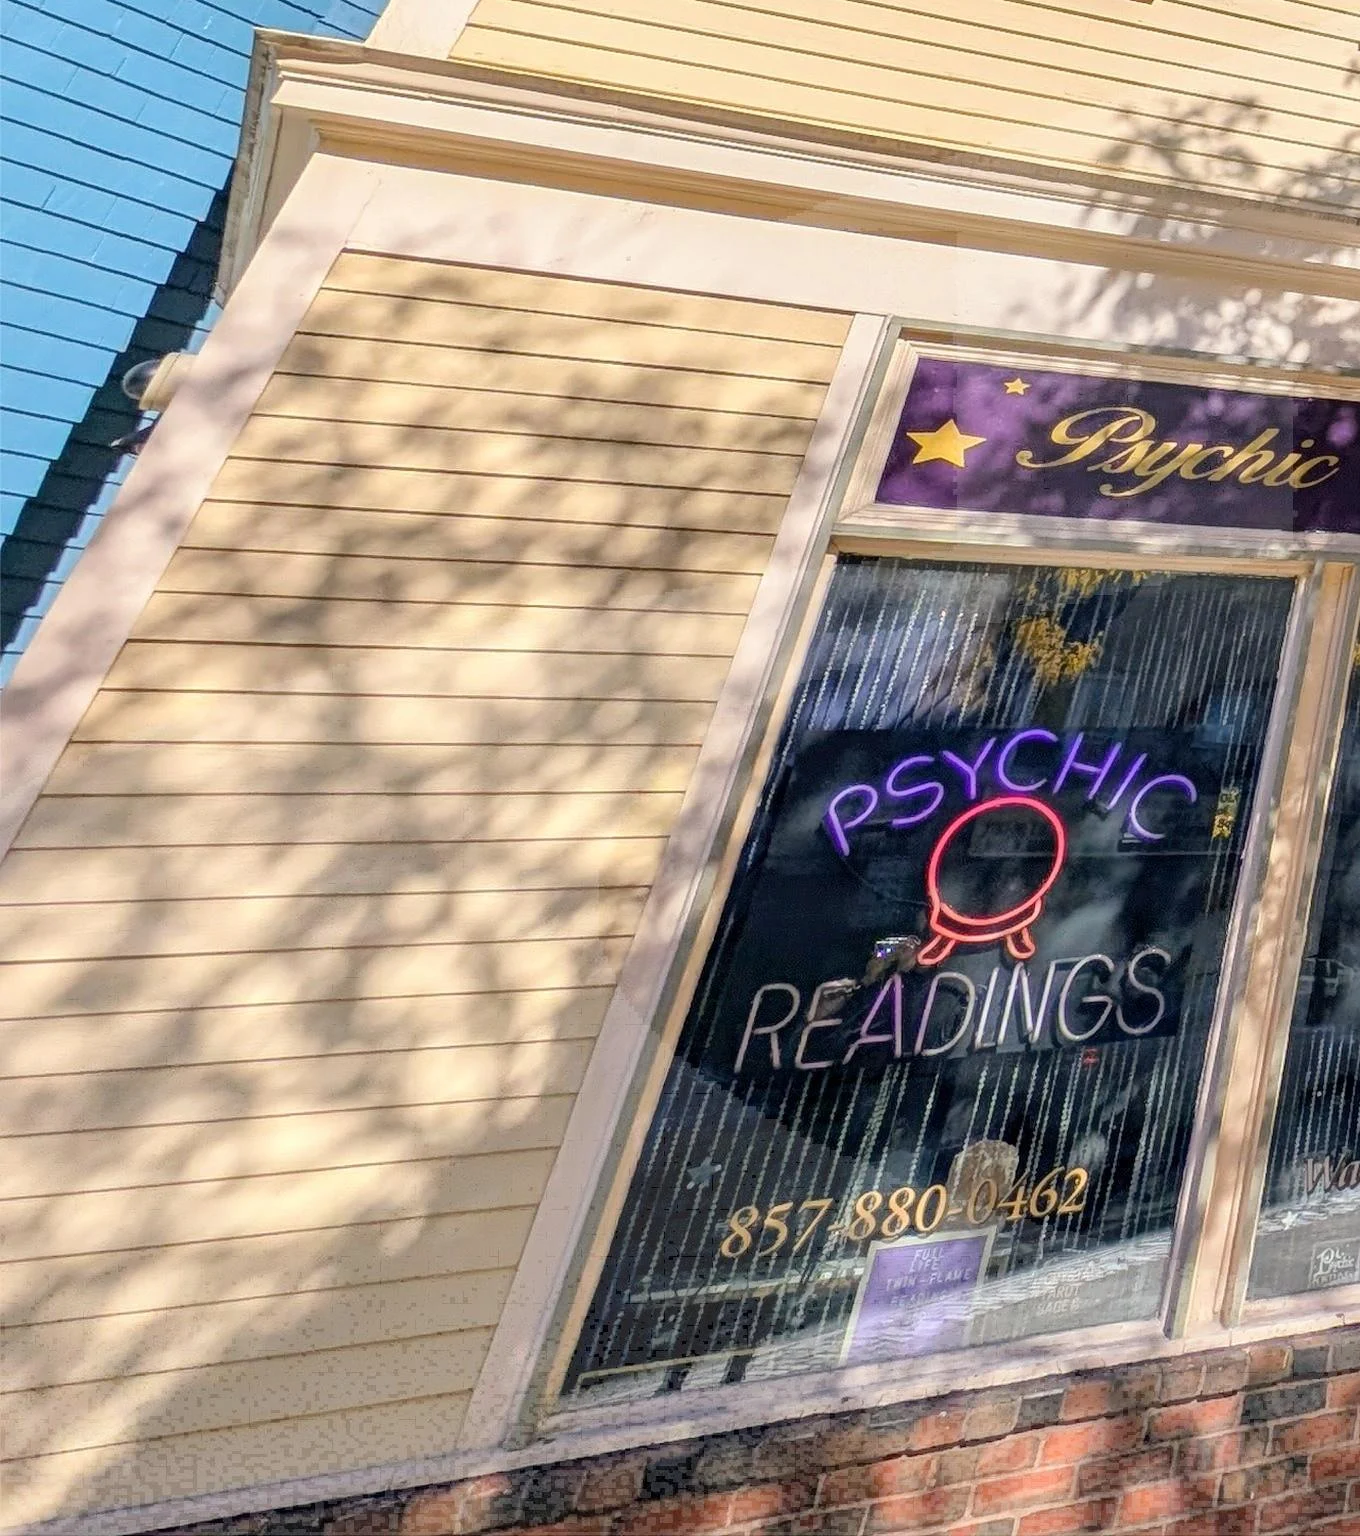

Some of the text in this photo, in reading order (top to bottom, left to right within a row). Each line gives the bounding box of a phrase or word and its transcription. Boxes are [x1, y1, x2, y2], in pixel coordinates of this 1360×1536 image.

[1016, 406, 1342, 499] Psychic
[825, 727, 1198, 857] PSYCHIC
[733, 945, 1176, 1074] READINGS
[719, 1166, 1090, 1259] 857-880-0462
